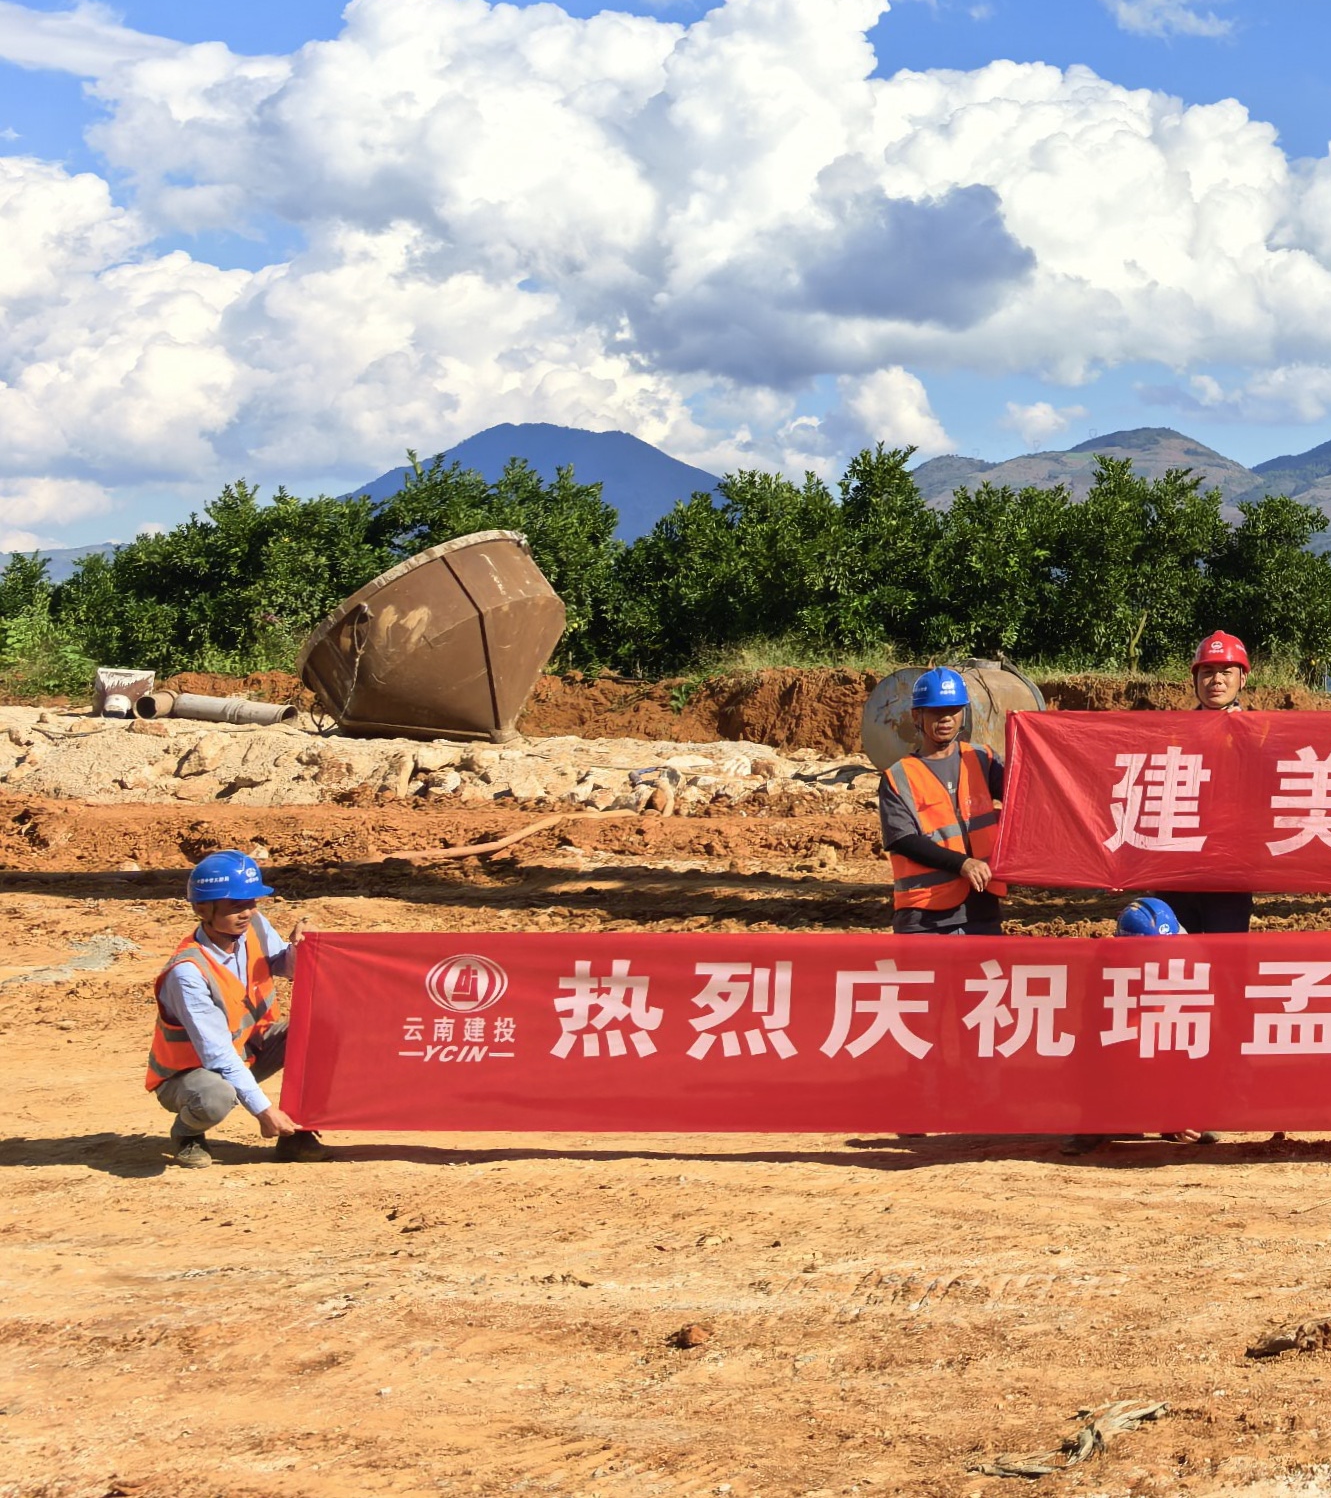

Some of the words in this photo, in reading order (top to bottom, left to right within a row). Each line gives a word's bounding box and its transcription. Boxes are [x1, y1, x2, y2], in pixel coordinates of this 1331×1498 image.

[402, 1016, 516, 1043] 云南建投
[423, 1045, 488, 1062] YCIN
